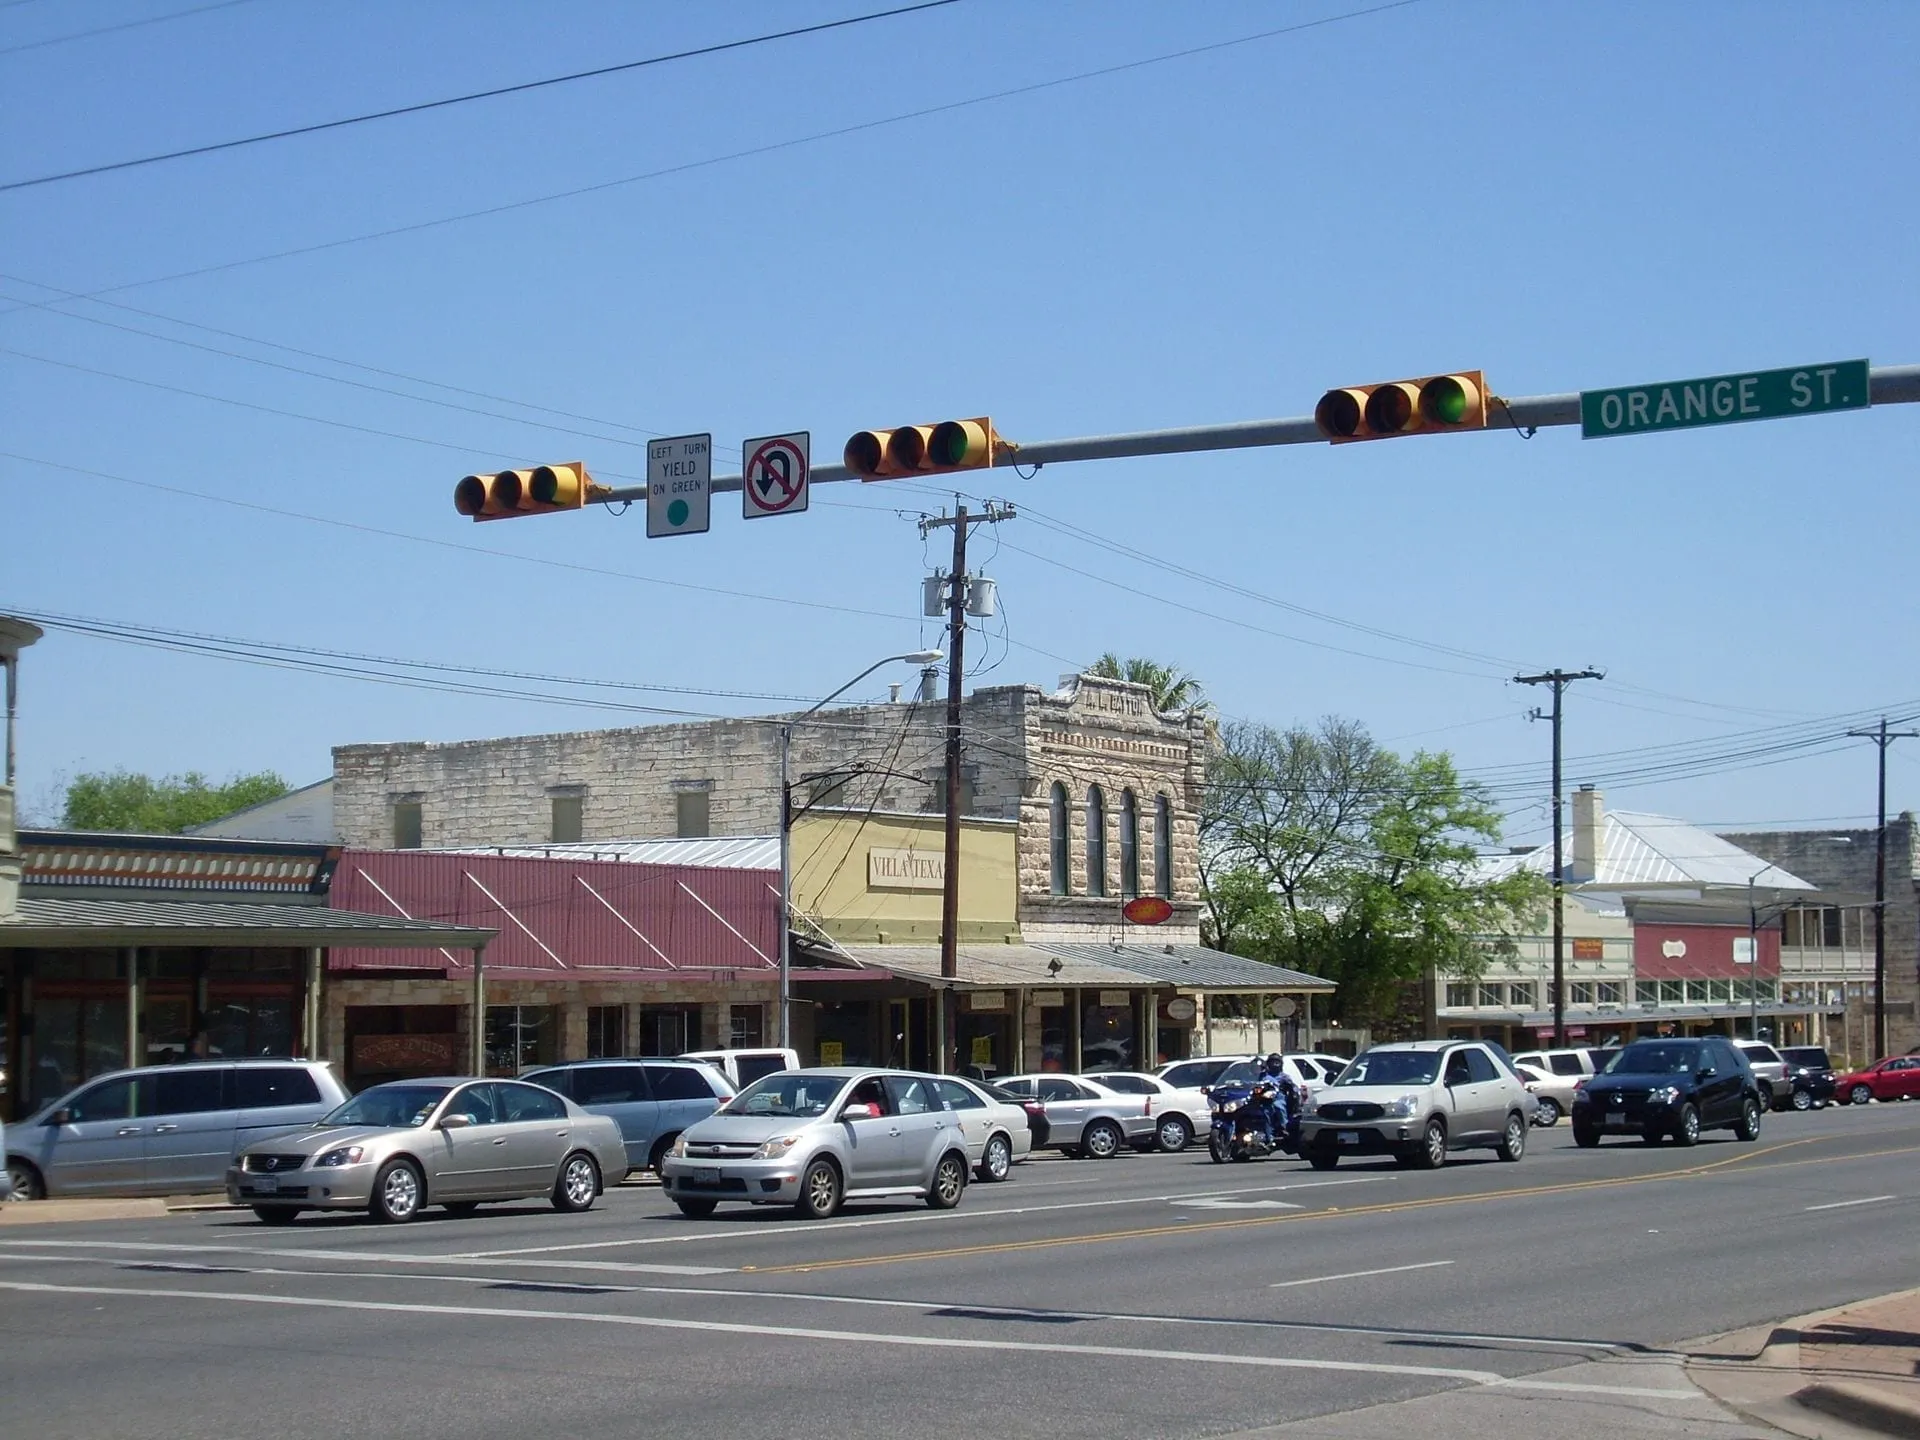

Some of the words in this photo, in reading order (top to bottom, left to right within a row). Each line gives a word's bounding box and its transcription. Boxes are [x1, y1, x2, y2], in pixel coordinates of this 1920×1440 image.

[1600, 377, 1760, 429] ORANGE
[1790, 368, 1850, 408] ST.
[651, 446, 672, 460] LEFT
[684, 442, 707, 456] TURN
[662, 460, 696, 478] YIELD
[653, 483, 665, 495] ON
[672, 479, 701, 493] GREEN
[873, 856, 908, 878] VILLA
[913, 858, 944, 879] TEXA
